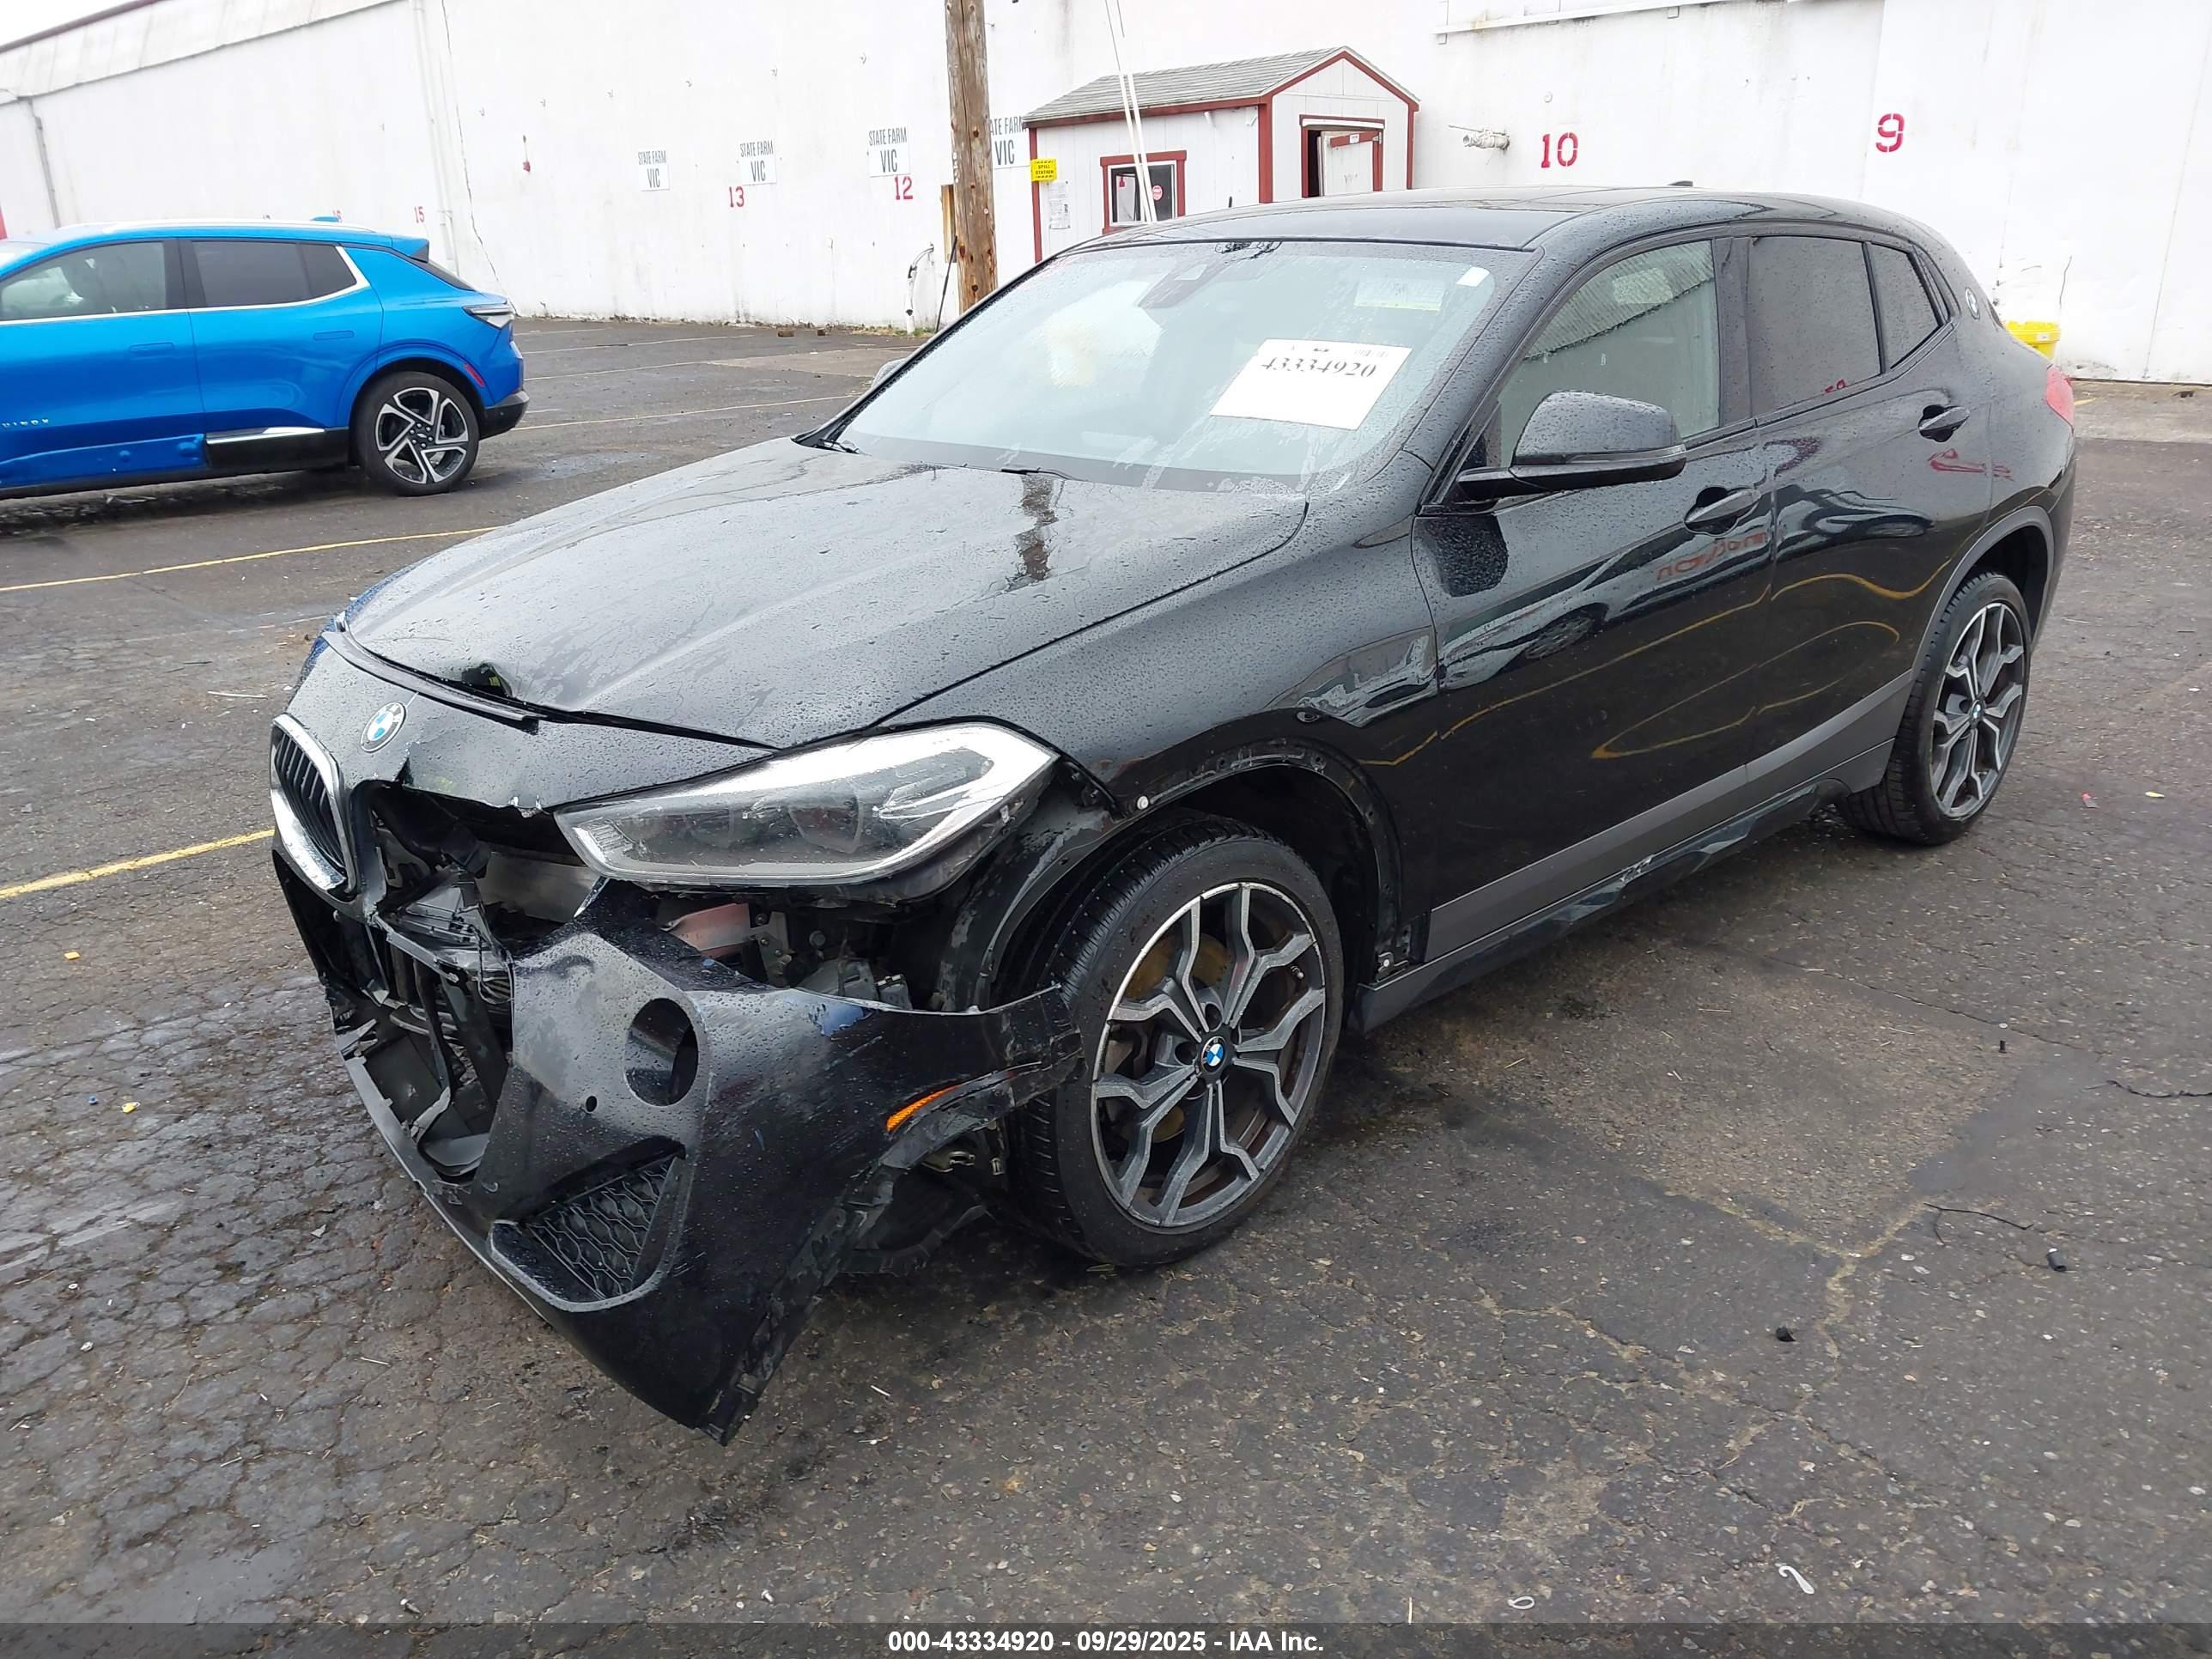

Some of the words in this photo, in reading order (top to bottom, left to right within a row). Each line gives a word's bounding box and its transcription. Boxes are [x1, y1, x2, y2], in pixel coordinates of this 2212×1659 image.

[868, 129, 887, 146] STATE
[887, 126, 908, 144] FARM
[1875, 112, 1905, 153] 9
[638, 150, 652, 165] STATE
[739, 142, 757, 158] STATE
[757, 139, 774, 156] FARM
[994, 139, 1015, 166] VIC
[1540, 131, 1578, 168] 10
[750, 160, 766, 182] VIC
[879, 149, 898, 173] VIC
[647, 167, 660, 188] VIC
[894, 175, 914, 200] 12
[728, 185, 744, 208] 13
[414, 205, 425, 223] 15
[1261, 356, 1376, 378] 43334920
